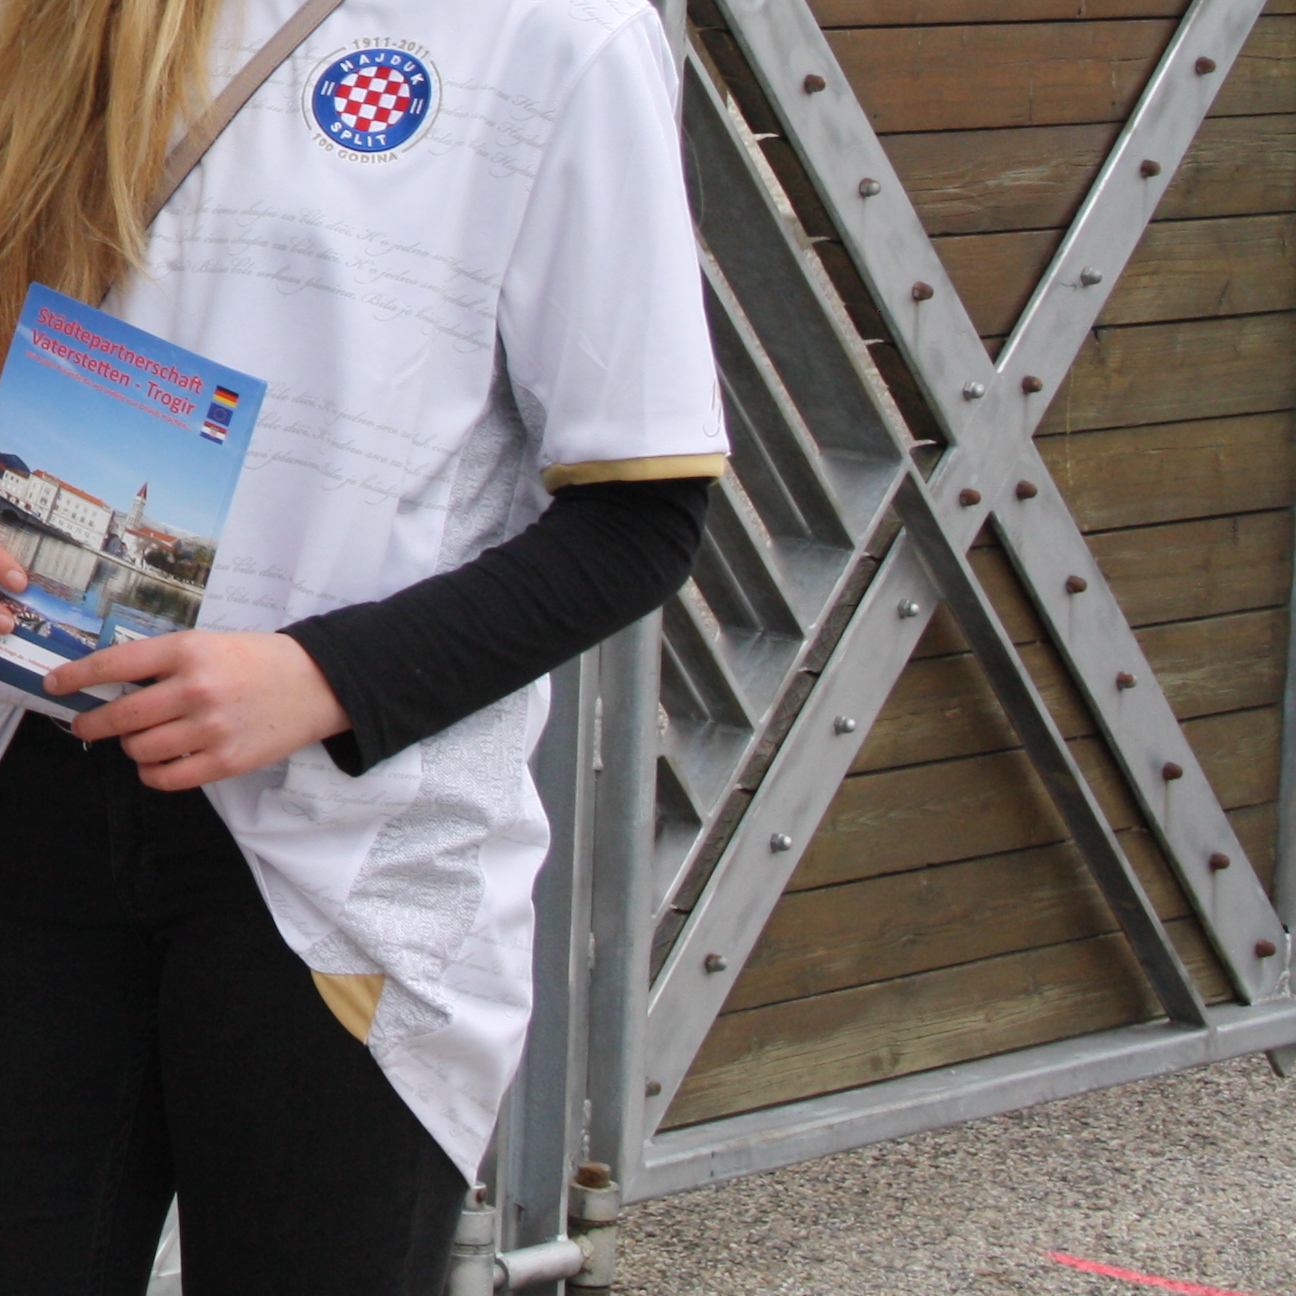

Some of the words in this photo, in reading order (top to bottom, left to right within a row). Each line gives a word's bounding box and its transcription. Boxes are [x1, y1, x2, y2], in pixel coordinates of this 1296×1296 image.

[352, 36, 431, 60] 1911-2011
[339, 52, 424, 86] HAJDUK
[311, 132, 335, 152] 100
[337, 148, 399, 165] GODINA
[330, 121, 388, 147] SPLIT
[36, 307, 204, 395] Städtepartnerschaft
[31, 328, 131, 388] Vaterstetten
[145, 380, 196, 415] Trogir
